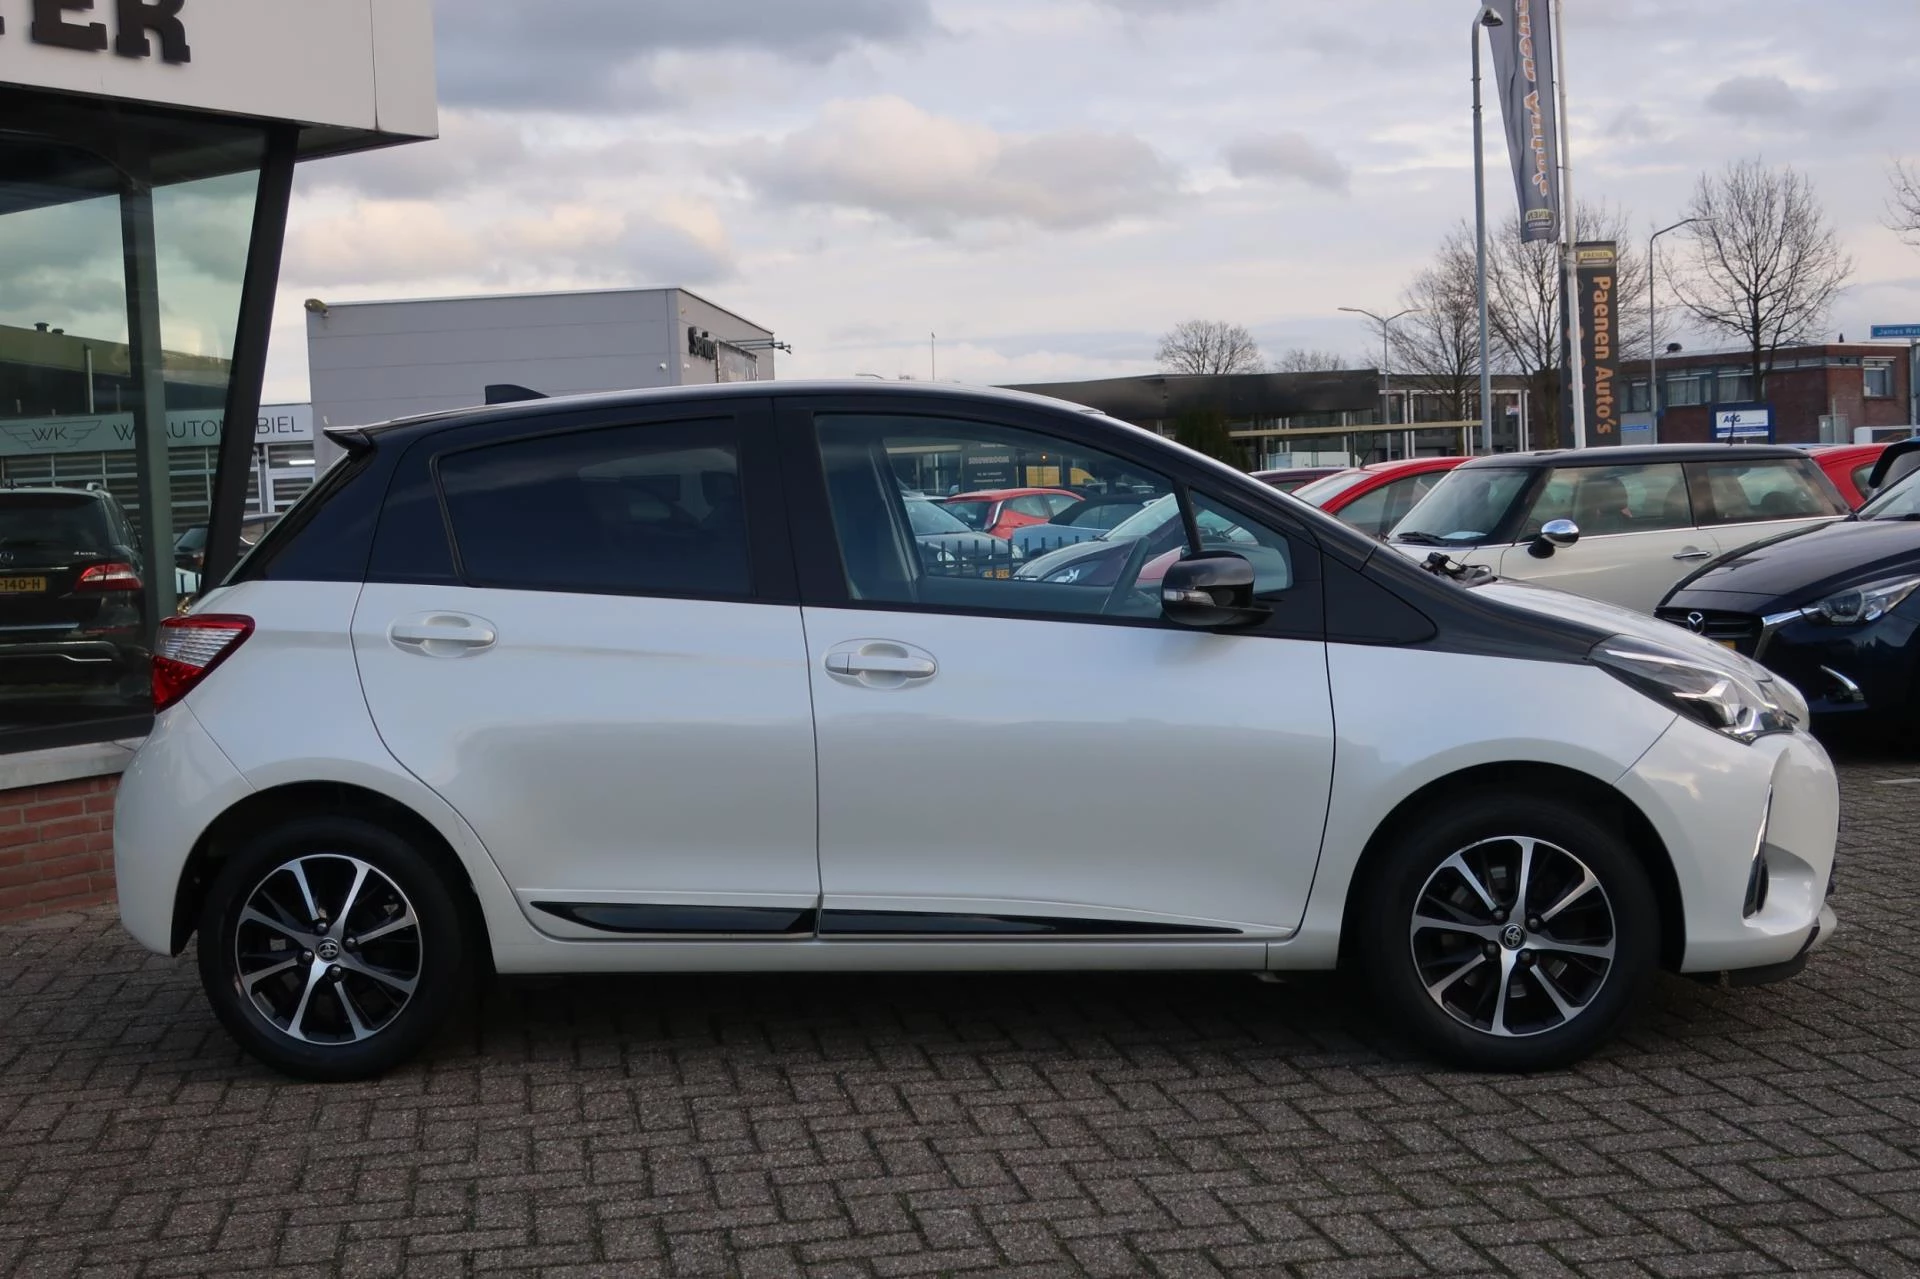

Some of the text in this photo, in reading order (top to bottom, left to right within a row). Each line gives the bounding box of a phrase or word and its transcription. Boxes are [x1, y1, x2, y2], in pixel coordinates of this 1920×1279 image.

[0, 0, 191, 63] ER
[1877, 328, 1904, 336] James
[1593, 276, 1617, 435] Paenen Auto's
[32, 426, 68, 441] WK
